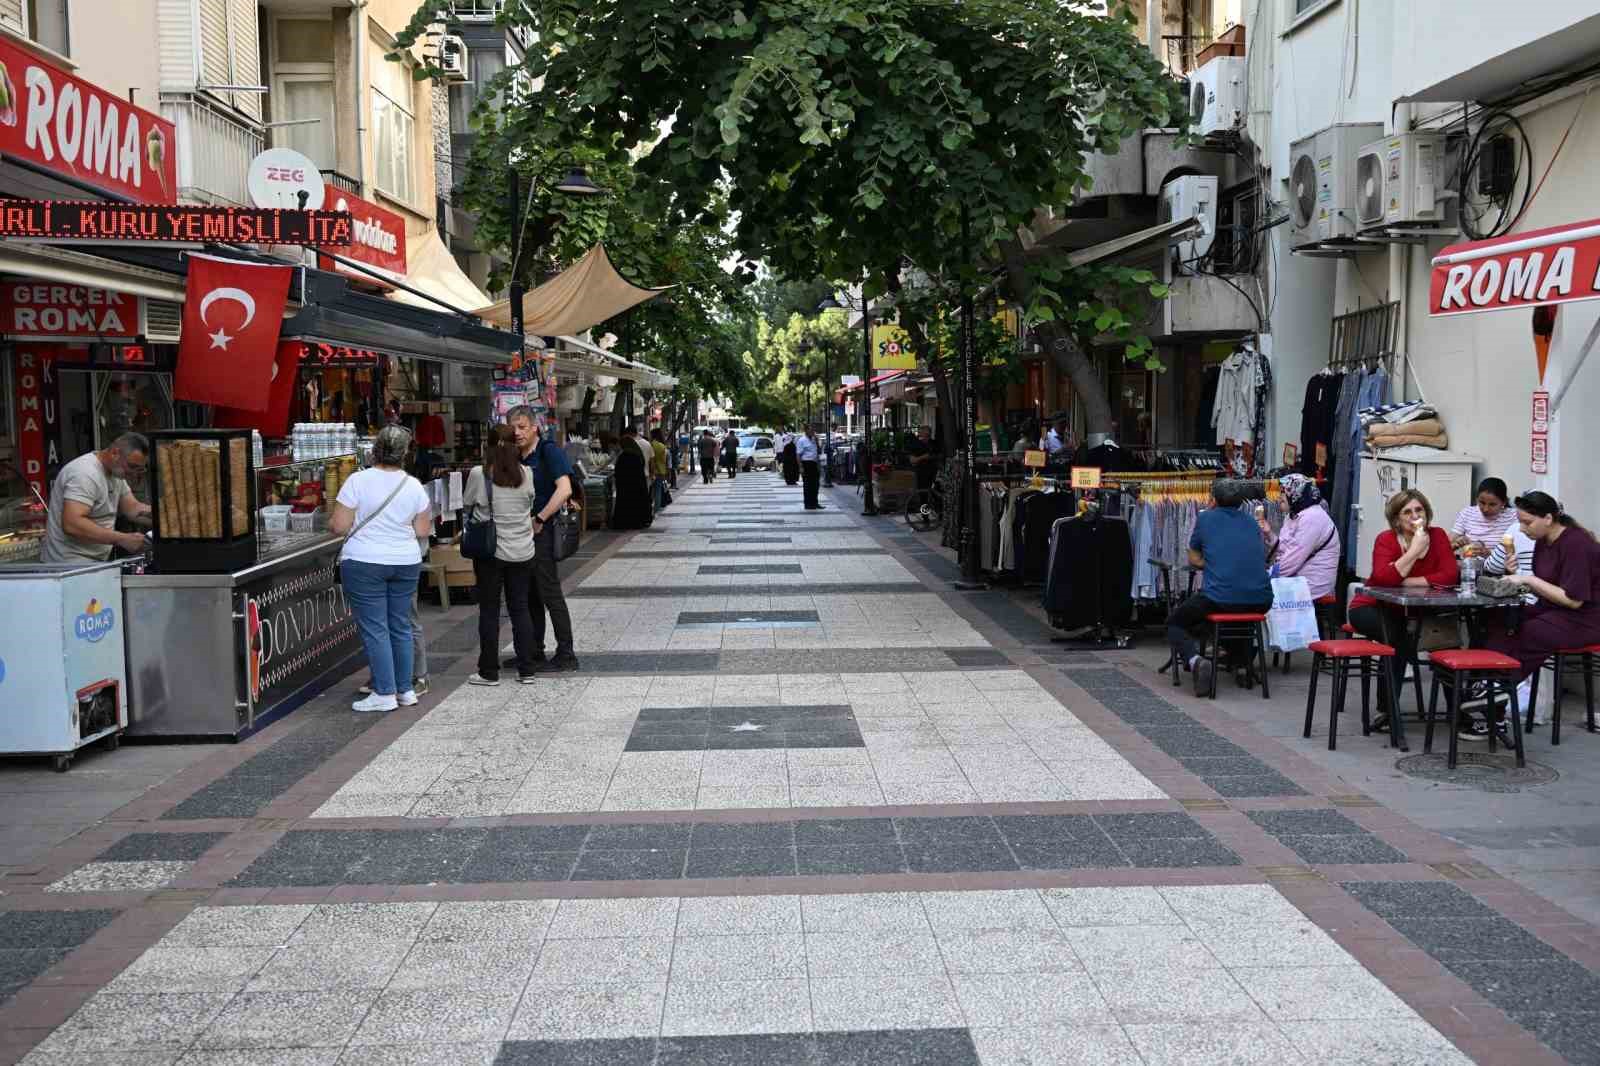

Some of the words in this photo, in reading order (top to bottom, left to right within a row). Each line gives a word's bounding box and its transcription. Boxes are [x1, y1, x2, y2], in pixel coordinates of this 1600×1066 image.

[25, 66, 141, 188] ROMA
[80, 209, 158, 236] KURU
[308, 210, 349, 241] İTA
[1441, 246, 1576, 309] ROMA
[13, 286, 125, 306] GERÇEK
[15, 307, 125, 333] ROMA
[20, 353, 39, 432] ROMA
[79, 613, 110, 634] ROMA
